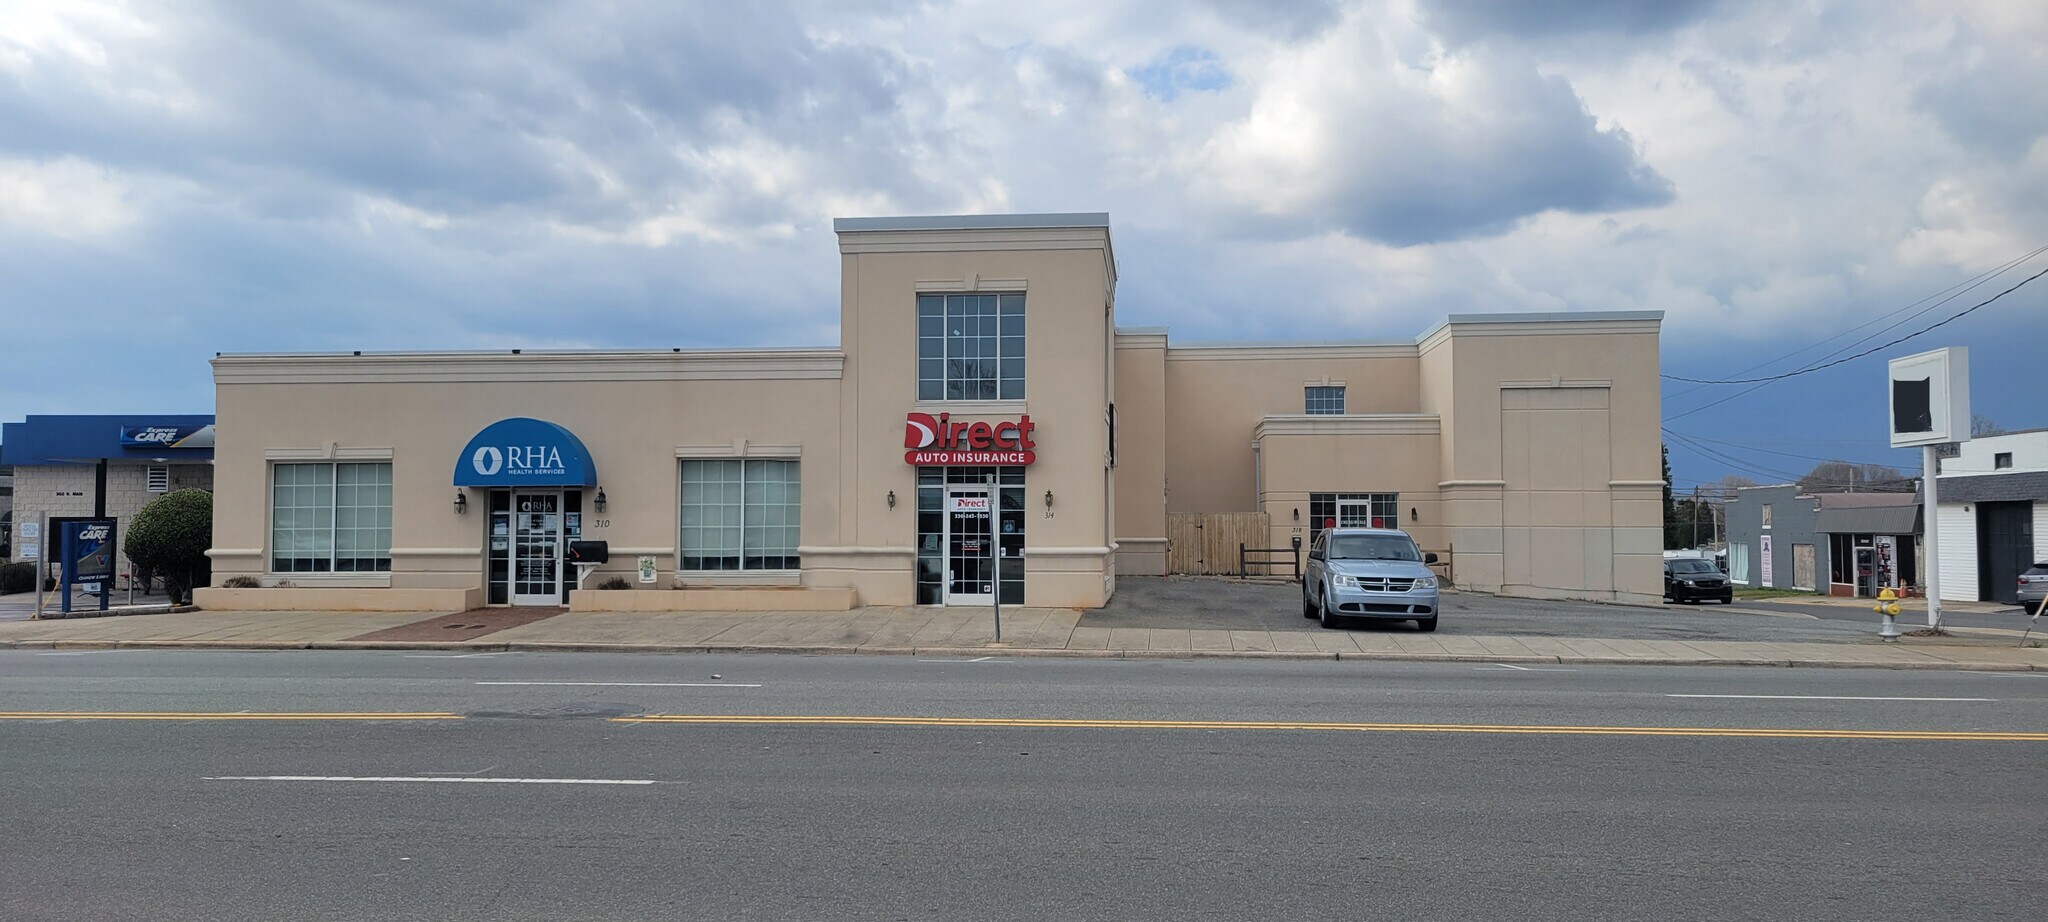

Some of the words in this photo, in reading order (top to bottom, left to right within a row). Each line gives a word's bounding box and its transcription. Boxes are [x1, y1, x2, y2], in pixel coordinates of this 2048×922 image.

[905, 412, 1036, 449] Direct
[135, 433, 176, 443] CARE
[506, 446, 565, 468] RHA
[915, 453, 949, 463] AUTO
[953, 453, 1025, 463] INSURANCE
[533, 501, 553, 510] RHA
[957, 499, 986, 507] Direct
[594, 519, 611, 528] 310
[79, 530, 108, 541] CARE
